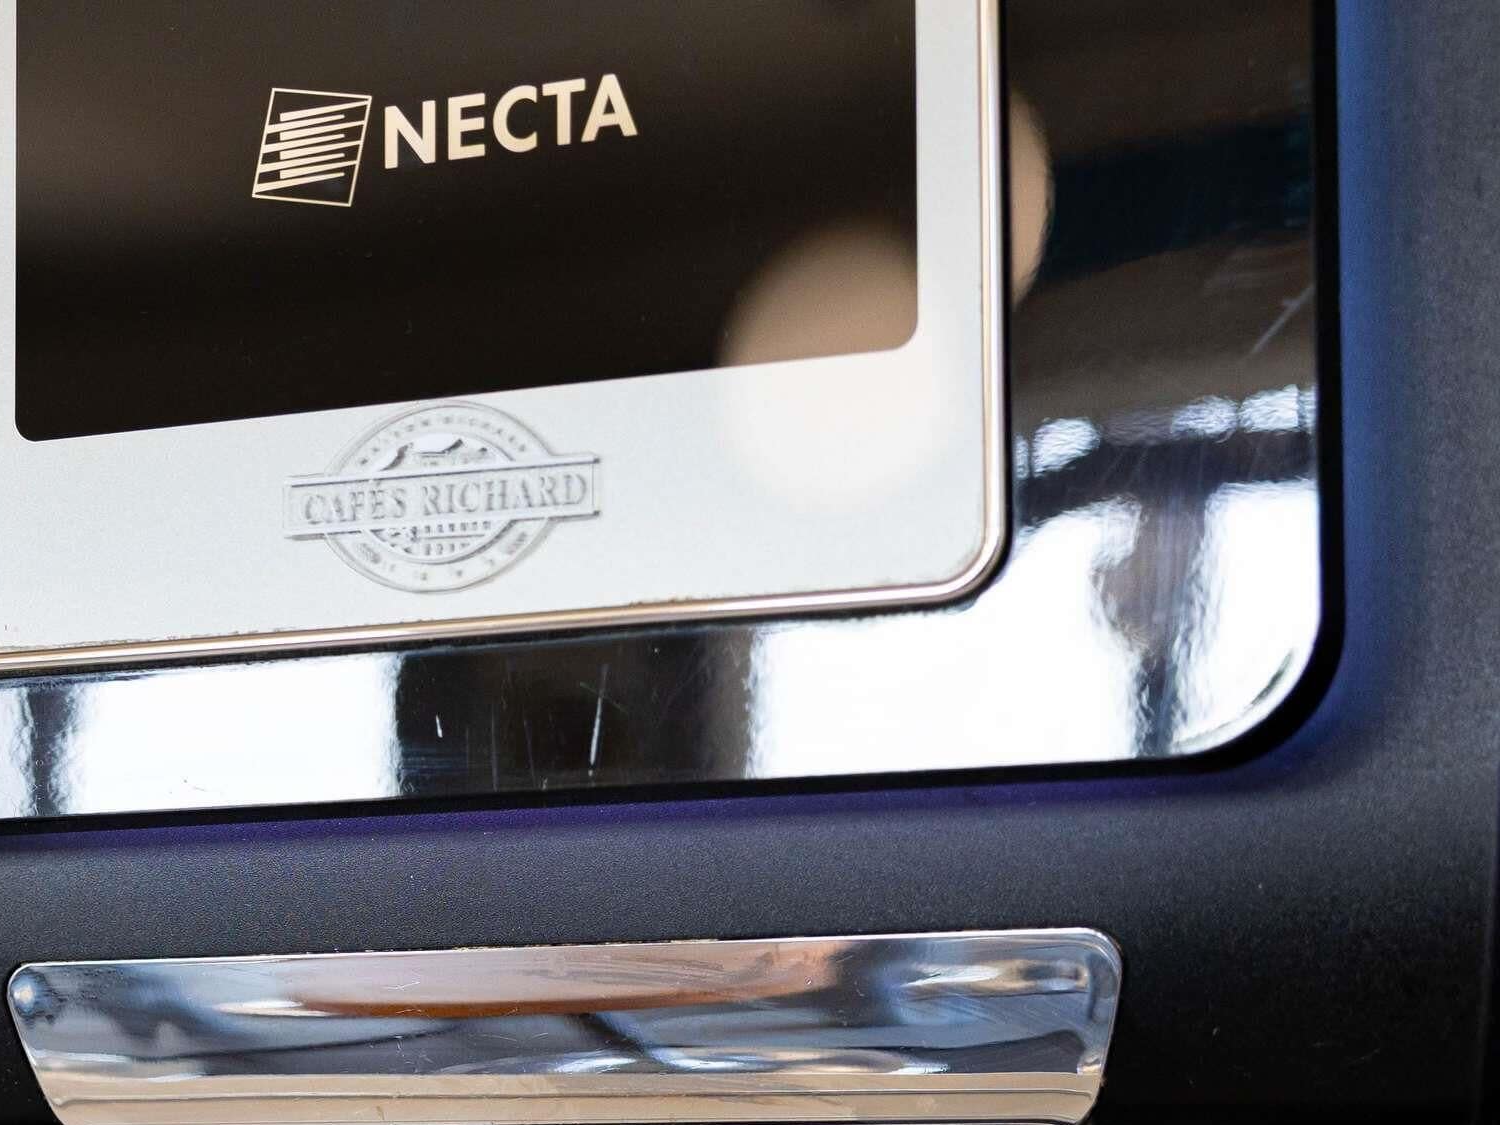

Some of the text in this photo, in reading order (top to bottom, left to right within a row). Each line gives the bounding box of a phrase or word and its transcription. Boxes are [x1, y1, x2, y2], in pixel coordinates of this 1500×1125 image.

[384, 73, 638, 169] NECTA
[304, 474, 588, 525] CAFÉS RICHARD
